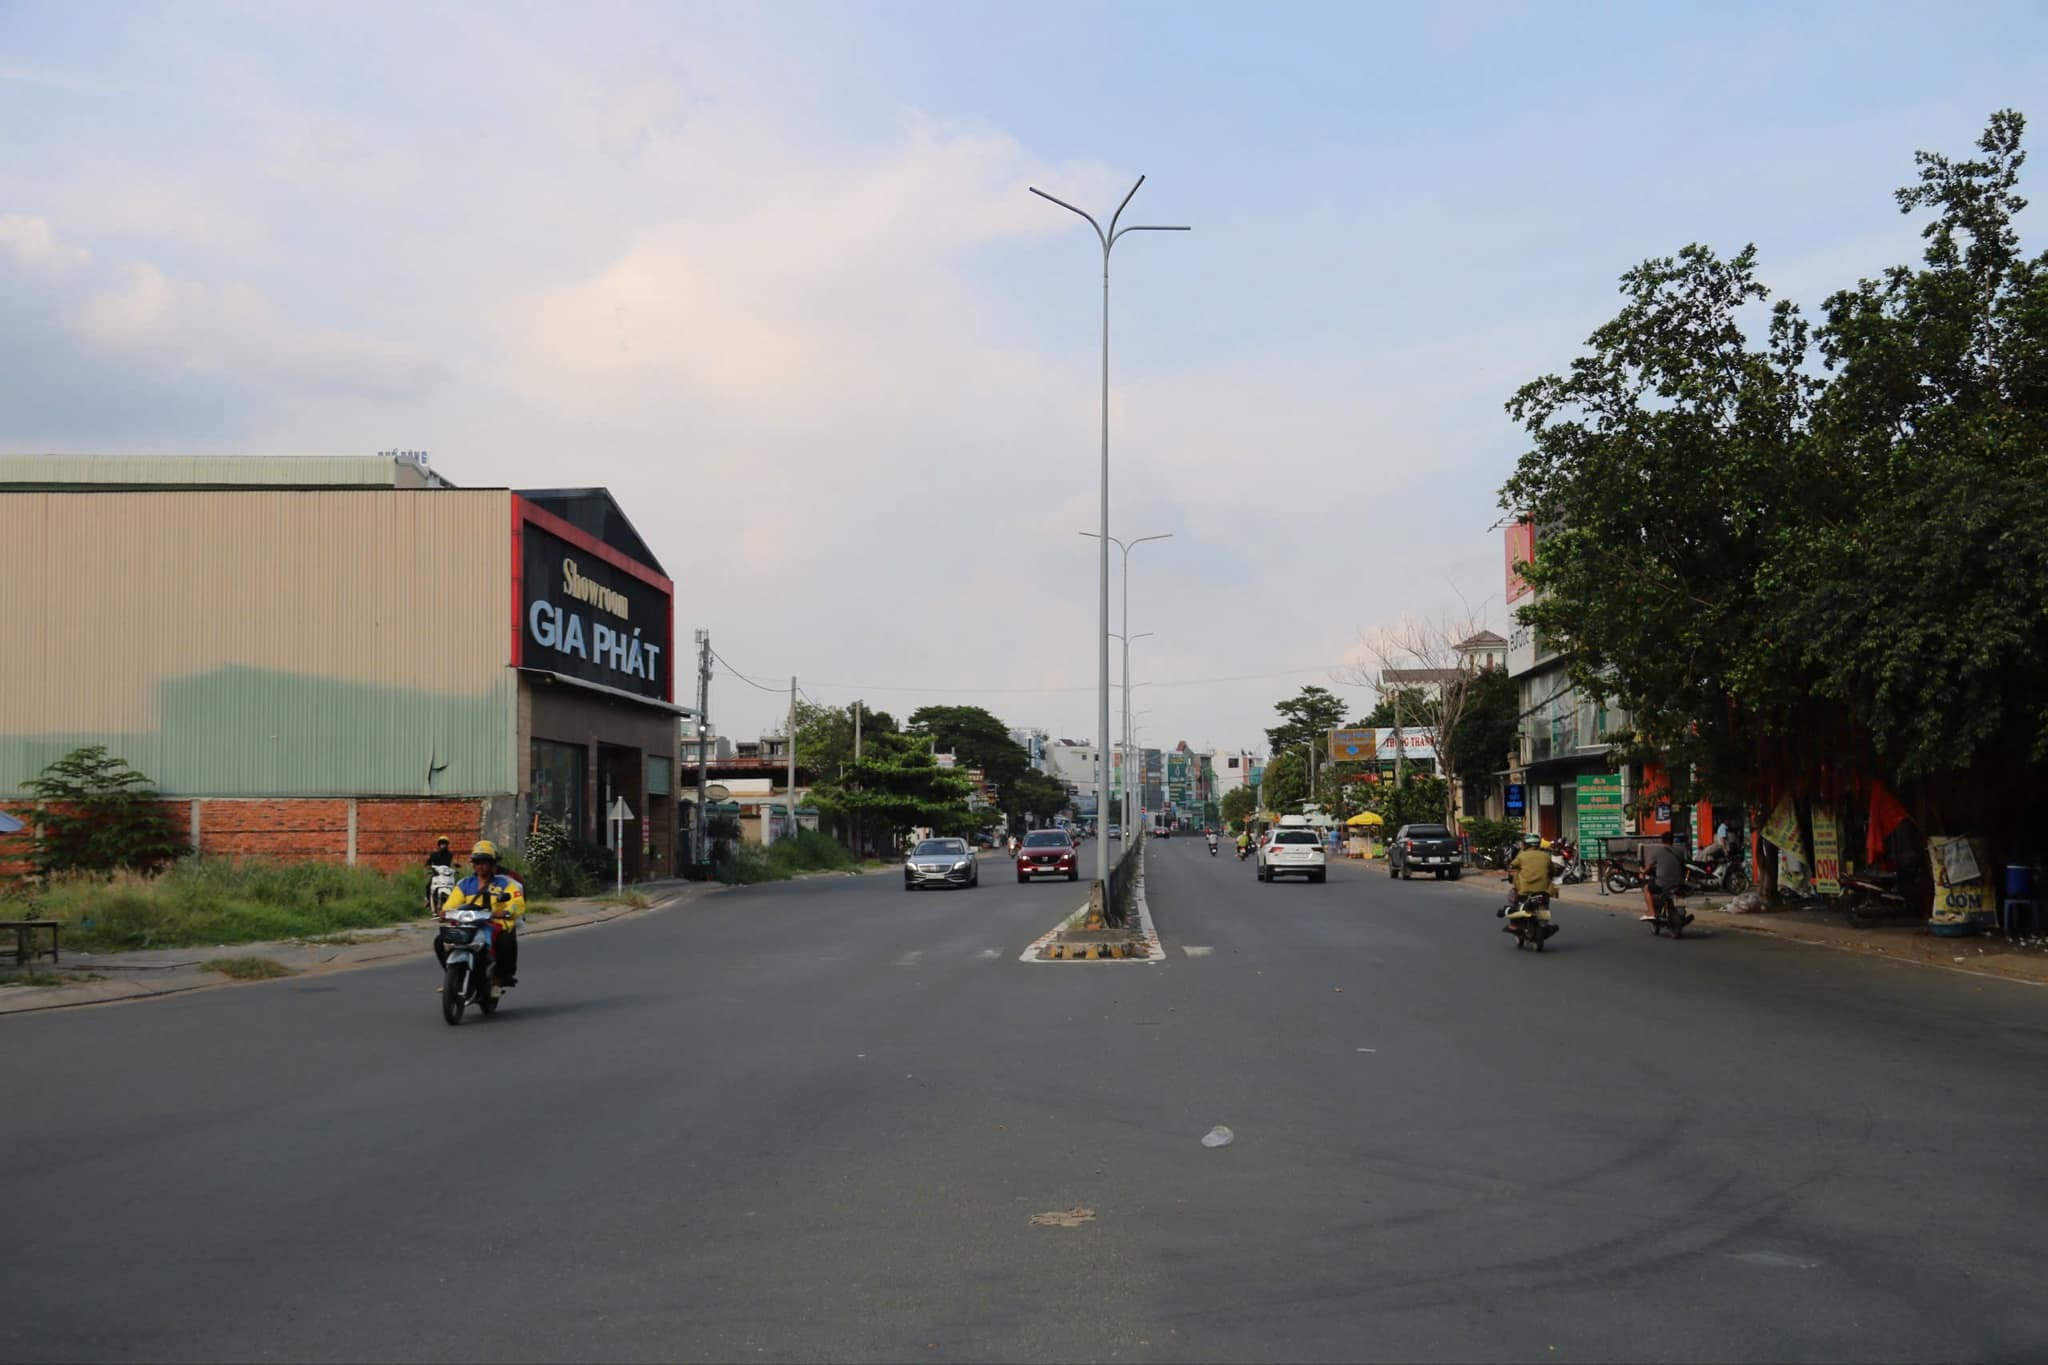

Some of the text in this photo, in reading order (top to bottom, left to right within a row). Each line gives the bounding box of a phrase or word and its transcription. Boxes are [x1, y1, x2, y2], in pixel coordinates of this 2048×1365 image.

[563, 558, 628, 620] Showroom
[529, 600, 660, 681] GIA PHÁT
